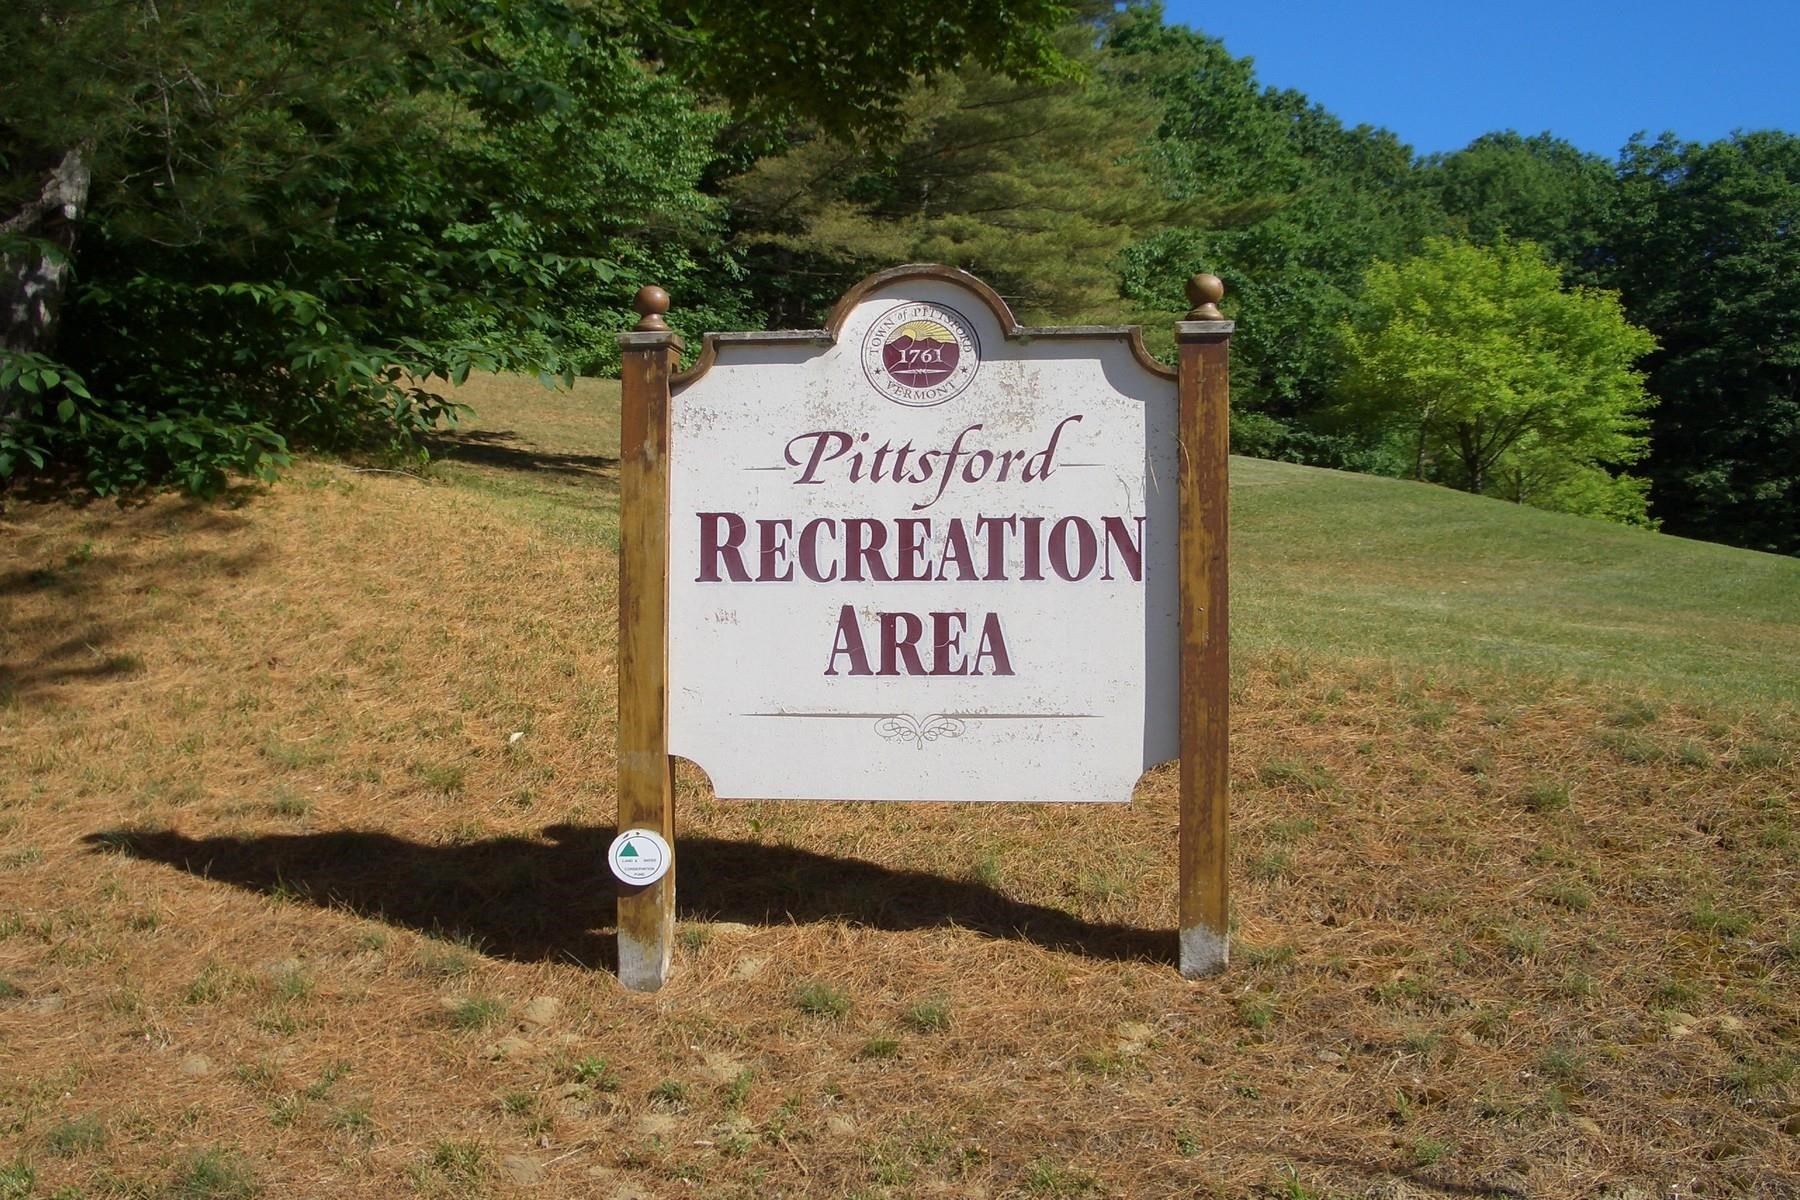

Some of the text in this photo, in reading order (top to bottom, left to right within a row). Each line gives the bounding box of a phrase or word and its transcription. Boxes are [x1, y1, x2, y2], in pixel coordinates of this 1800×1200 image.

[869, 308, 973, 354] TOWN of PITTSFORD
[899, 349, 943, 363] 1761
[886, 380, 956, 400] VERMONT
[784, 414, 1083, 511] Pittsford
[694, 511, 1147, 583] RECREATION
[823, 604, 1016, 677] AREA
